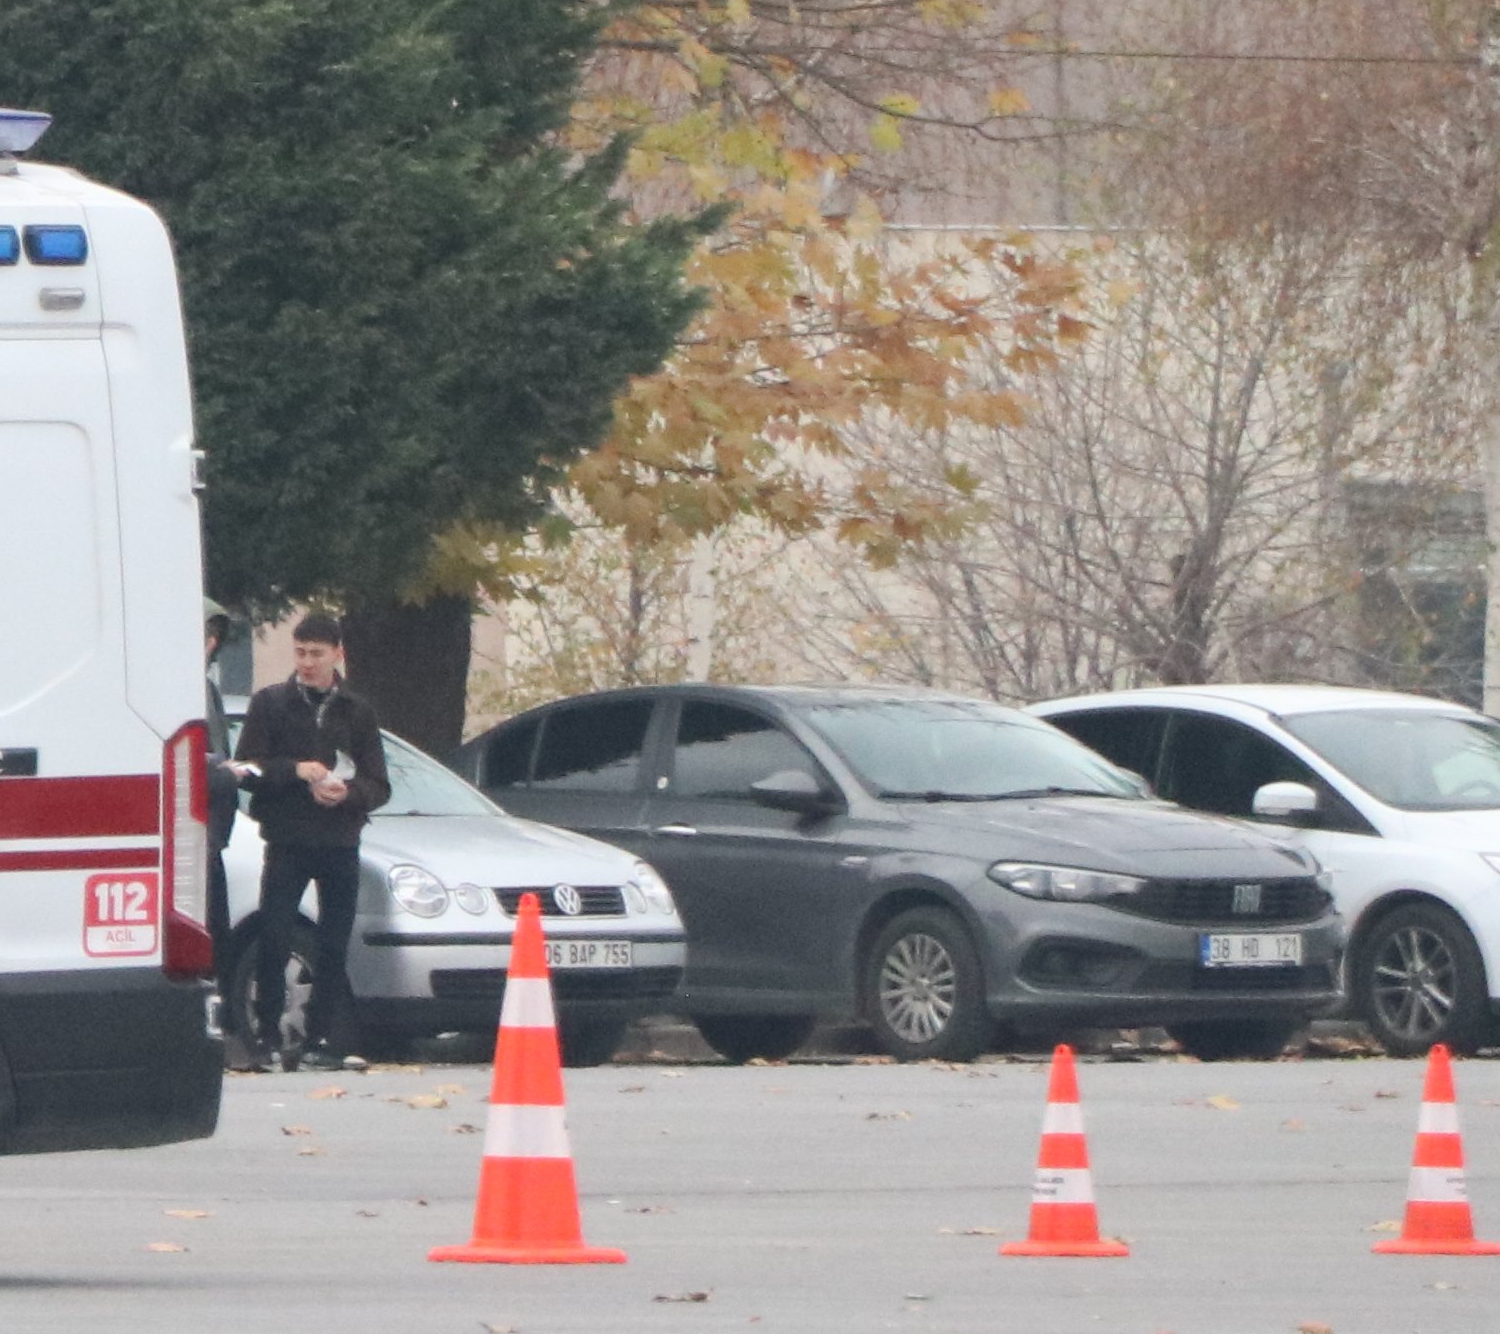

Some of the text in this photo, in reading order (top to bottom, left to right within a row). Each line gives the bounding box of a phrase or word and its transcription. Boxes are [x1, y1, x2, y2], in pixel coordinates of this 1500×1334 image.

[95, 881, 149, 922] 112
[603, 944, 629, 965] 755
[1211, 937, 1230, 959] 38
[1275, 936, 1298, 958] 121
